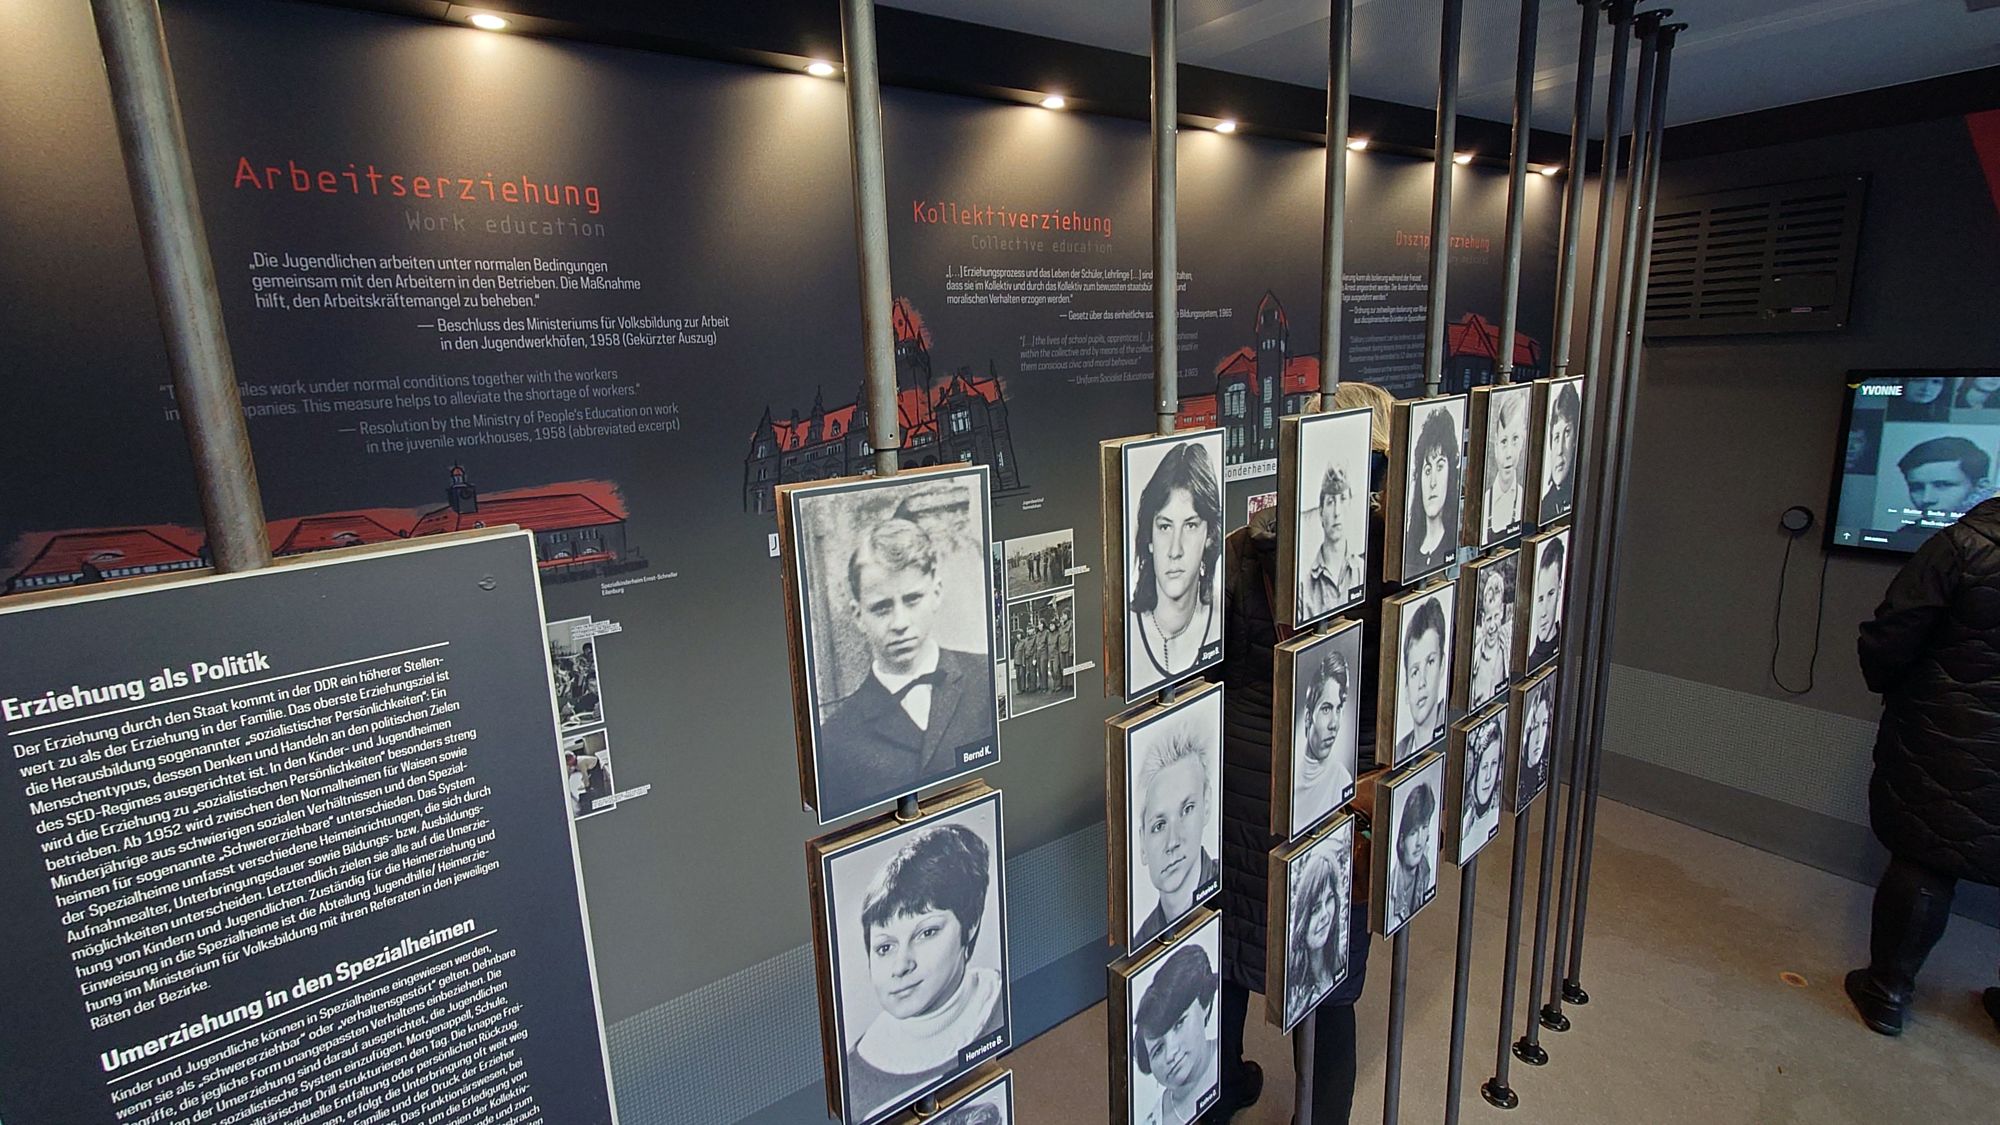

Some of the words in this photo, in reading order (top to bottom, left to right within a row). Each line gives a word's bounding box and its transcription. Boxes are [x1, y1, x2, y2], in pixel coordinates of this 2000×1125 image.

[234, 156, 600, 214] Arbeitserziehung
[406, 211, 465, 232] Work
[486, 215, 605, 237] education
[913, 201, 1112, 238] Kollektiverziehung
[282, 253, 376, 271] Jugendlichen
[379, 255, 435, 270] arbeiten
[438, 257, 472, 271] unter
[475, 258, 531, 272] normalen
[534, 258, 608, 274] Bedingungen
[971, 234, 1044, 252] Collective
[1052, 240, 1112, 253] education
[252, 273, 338, 291] gemeinsam
[341, 274, 364, 289] mit
[366, 274, 392, 289] den
[395, 274, 456, 289] Arbeitern
[458, 275, 470, 289] in
[472, 275, 496, 289] den
[498, 276, 558, 290] Betrieben.
[560, 276, 578, 290] Die
[580, 276, 641, 290] Maßnahme
[255, 293, 290, 310] hilft,
[293, 293, 320, 308] den
[324, 292, 461, 310] Arbeitskräftemangel
[464, 296, 478, 308] zu
[437, 318, 500, 332] Beschluss
[503, 317, 524, 331] des
[527, 316, 598, 331] Ministeriums
[600, 316, 616, 330] für
[618, 316, 682, 331] Volksbildung
[684, 317, 699, 329] zur
[701, 315, 730, 328] Arbeit
[440, 338, 452, 351] in
[455, 336, 479, 350] den
[481, 334, 588, 352] Jugendwerkhöfen,
[590, 333, 620, 347] 1958
[622, 332, 676, 348] (Gekürzter
[678, 331, 718, 346] Auszug)
[1861, 385, 1904, 396] YVONNE
[367, 440, 379, 454] in
[382, 438, 404, 453] the
[406, 434, 454, 454] juvenile
[457, 431, 532, 447] workhouses,
[534, 426, 566, 441] 1958
[568, 422, 636, 440] (abbreviated
[638, 418, 681, 432] excerpt)
[1224, 462, 1276, 478] onderheime
[1, 680, 144, 721] Erziehung
[149, 668, 188, 691] als
[191, 650, 269, 682] Politik
[13, 743, 40, 758] Der
[43, 727, 118, 751] Erziehung
[120, 715, 161, 734] durch
[164, 711, 190, 724] den
[192, 702, 228, 718] Staat
[230, 691, 275, 710] kommt
[277, 689, 289, 700] in
[291, 684, 311, 696] der
[313, 677, 338, 692] DDR
[340, 674, 357, 686] ein
[358, 665, 401, 682] höherer
[403, 657, 443, 672] Stellen-
[19, 759, 55, 777] wert
[58, 756, 76, 768] zu
[79, 748, 101, 763] als
[103, 744, 127, 757] der
[130, 728, 199, 751] Erziehung
[200, 724, 213, 735] in
[216, 719, 237, 731] der
[239, 708, 286, 726] Familie.
[287, 703, 311, 715] Das
[313, 692, 357, 709] oberste
[359, 672, 434, 699] Erziehungsziel
[436, 670, 449, 681] ist
[25, 781, 49, 796] die
[50, 757, 156, 789] Herausbildung
[157, 736, 240, 764] sogenannter
[430, 687, 446, 699] Ein
[29, 779, 150, 814] Menschentypus,
[152, 765, 201, 784] dessen
[203, 752, 252, 771] Denken
[254, 742, 278, 759] und
[280, 732, 328, 752] Handeln
[330, 729, 345, 740] an
[347, 724, 369, 736] den
[370, 709, 428, 732] politischen
[429, 701, 459, 716] Zielen
[964, 746, 984, 763] Bernd
[35, 819, 64, 833] des
[65, 794, 161, 825] SED-Regimes
[163, 771, 246, 800] ausgerichtet
[248, 766, 268, 778] ist.
[269, 762, 281, 773] In
[283, 757, 306, 769] den
[308, 746, 349, 763] Kinder-
[351, 736, 373, 752] und
[375, 720, 451, 746] Jugendheimen
[45, 844, 120, 870] betrieben.
[123, 835, 141, 849] Ab
[144, 823, 182, 843] 1952
[184, 814, 213, 832] wird
[215, 800, 273, 824] zwischen
[275, 793, 298, 806] den
[300, 771, 381, 800] Normalheimen
[383, 765, 398, 777] für
[400, 755, 437, 772] Waisen
[438, 746, 467, 761] sowie
[90, 1008, 131, 1029] Räten
[133, 998, 155, 1013] der
[158, 981, 211, 1004] Bezirke.
[100, 1000, 262, 1071] Umerziehung
[265, 990, 288, 1008] in
[292, 973, 332, 998] den
[335, 919, 474, 980] Spezialheimen
[110, 1079, 153, 1103] Kinder
[156, 1065, 182, 1085] und
[185, 1037, 258, 1074] Jugendliche
[260, 1019, 304, 1042] können
[306, 1014, 317, 1024] in
[319, 985, 389, 1019] Spezialheime
[391, 959, 453, 989] eingewiesen
[454, 945, 491, 964] werden,
[333, 1078, 389, 1109] Entfaltung
[391, 1066, 414, 1082] oder
[416, 1038, 477, 1073] persönlichen
[478, 1020, 521, 1042] Rückzug.
